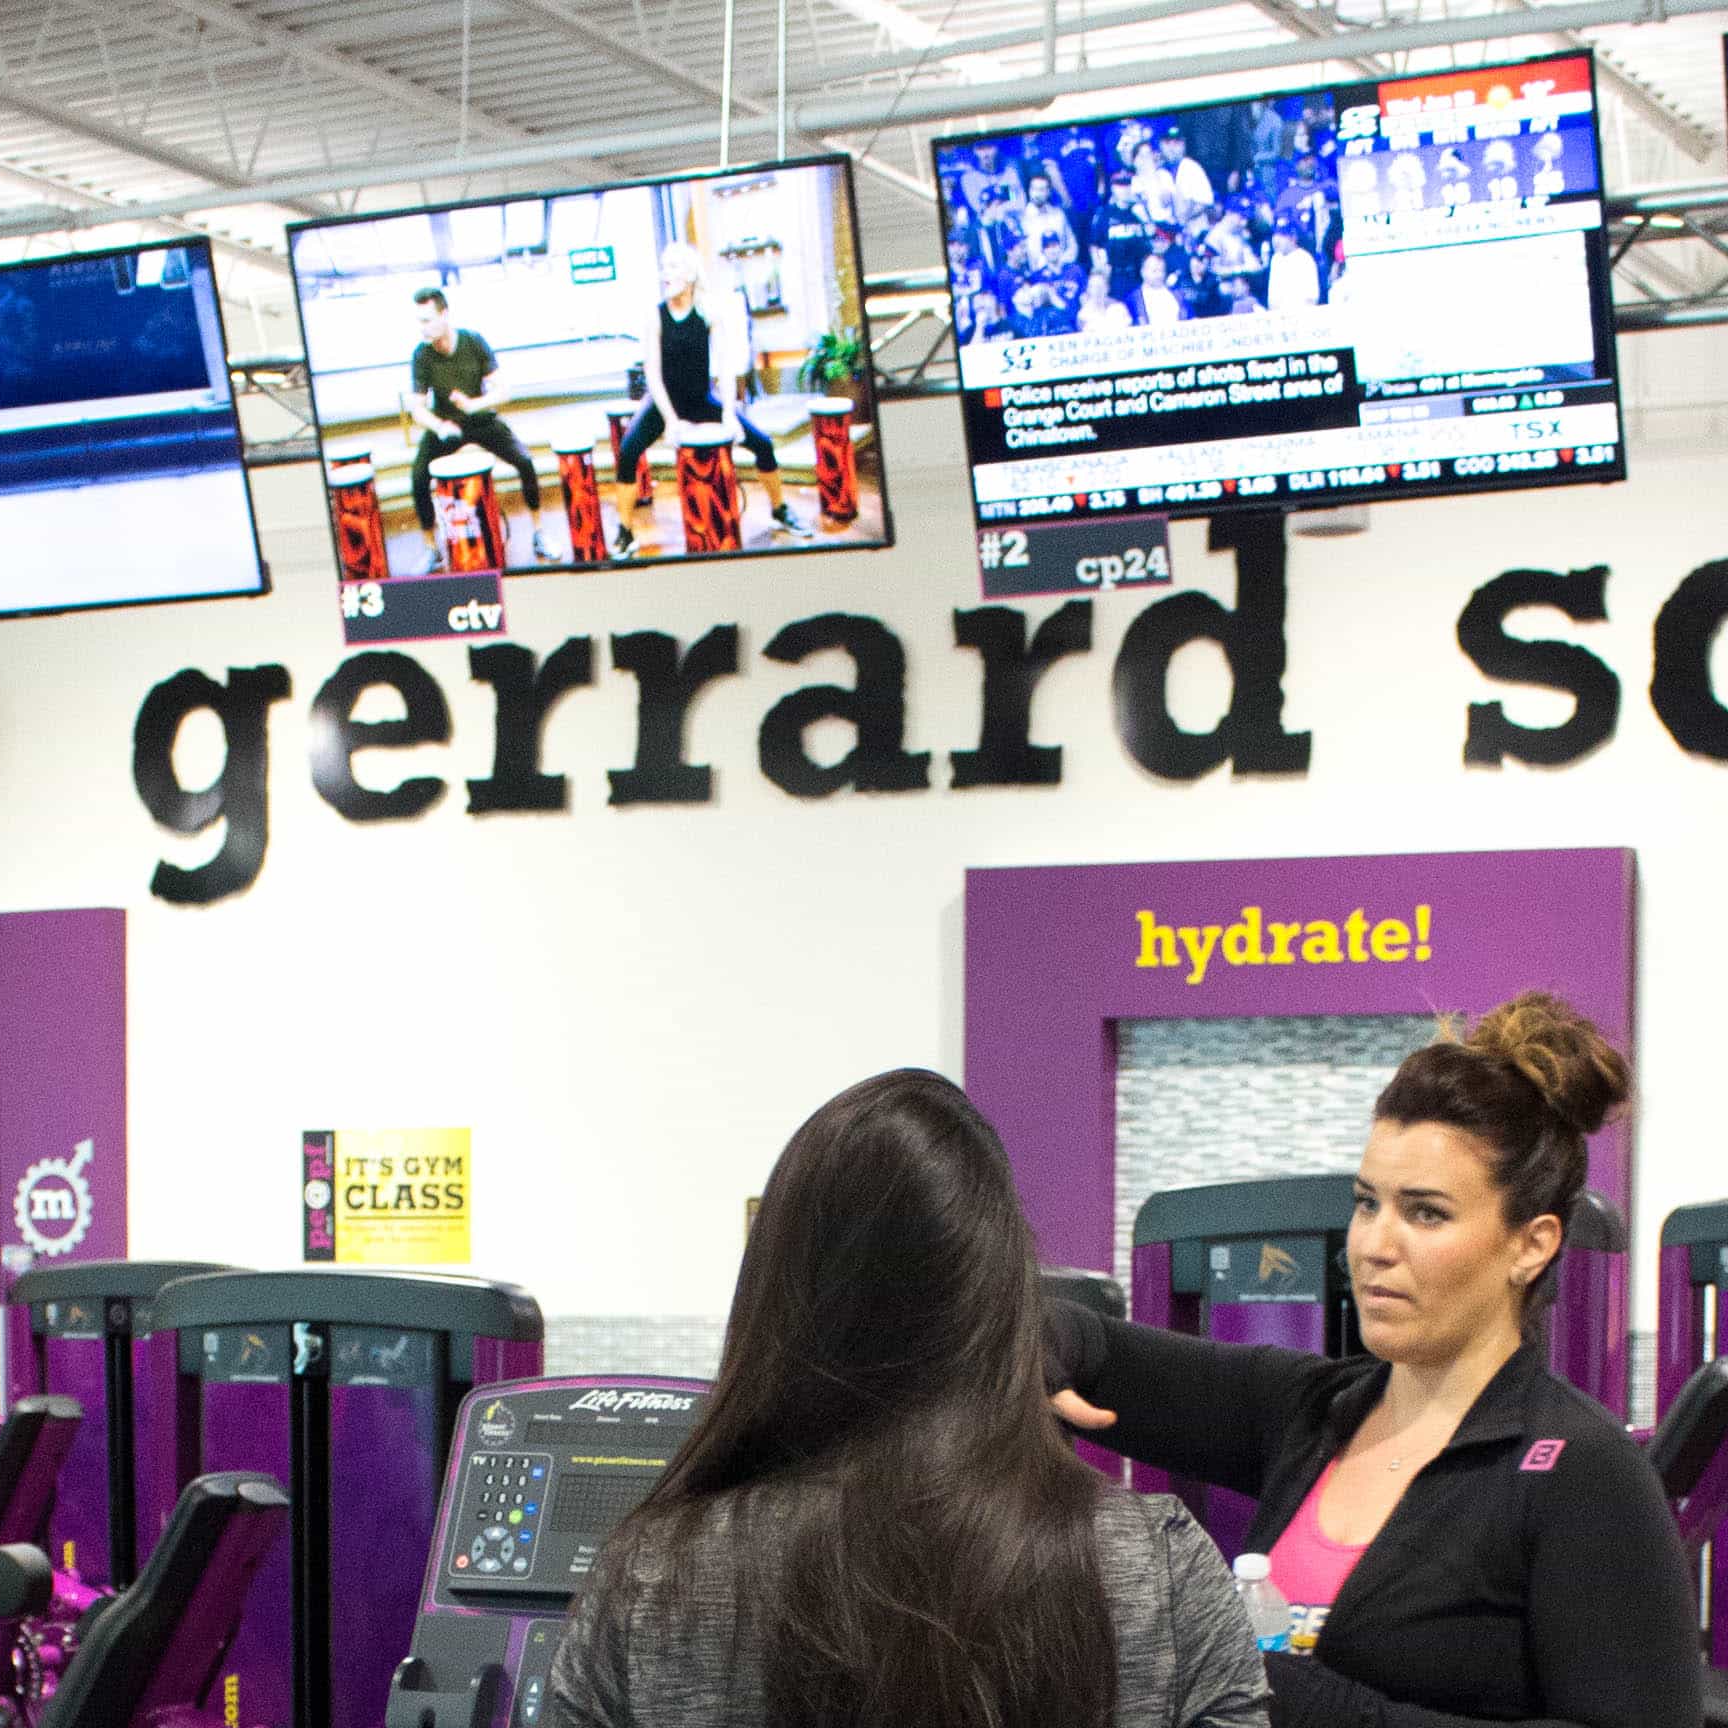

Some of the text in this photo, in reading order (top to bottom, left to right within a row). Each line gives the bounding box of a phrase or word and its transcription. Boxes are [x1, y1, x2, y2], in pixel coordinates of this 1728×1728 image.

[1003, 353, 1338, 405] Police receive reports of shots fired in the
[1003, 403, 1064, 427] Grange
[1066, 397, 1113, 420] Court
[1115, 394, 1148, 415] and
[1324, 374, 1344, 394] of
[1511, 419, 1563, 440] TSX
[979, 531, 1170, 590] #2 cp24
[342, 582, 502, 631] #3 ctv
[130, 518, 1312, 907] gerrard
[1135, 903, 1433, 985] hydrate!
[344, 1157, 463, 1176] IT'S GYM
[31, 1189, 76, 1219] m
[345, 1184, 464, 1210] CLASS
